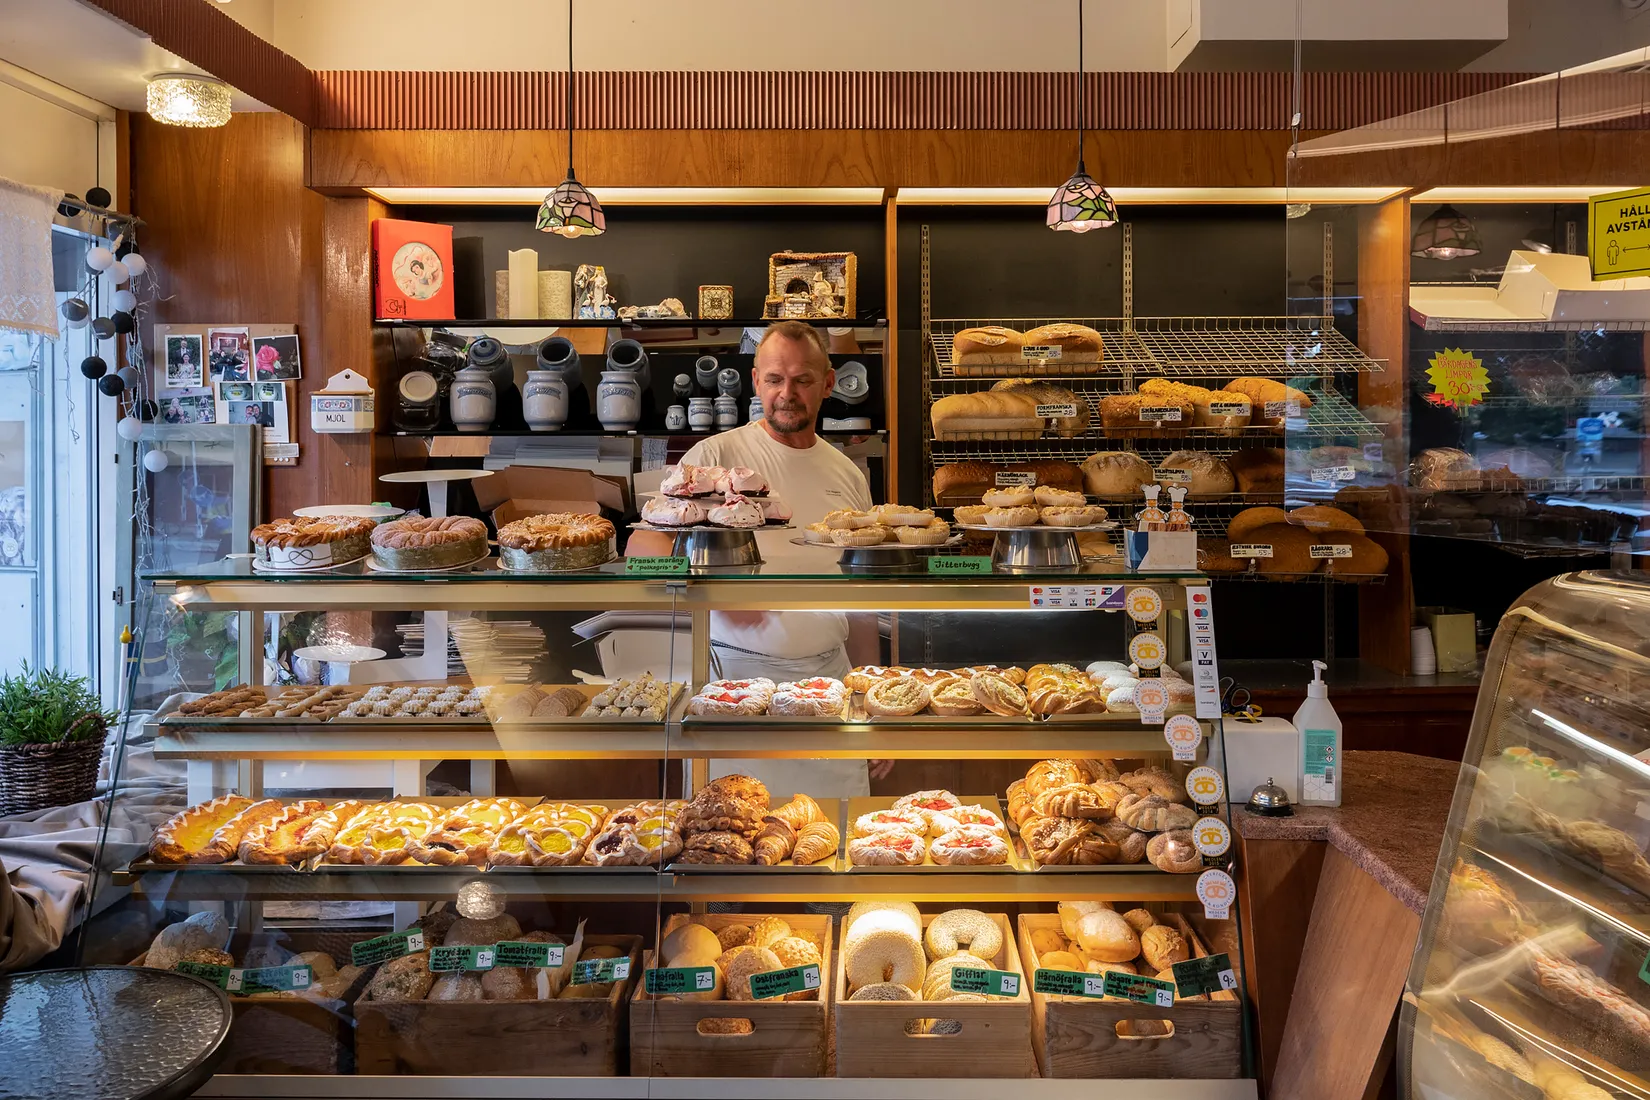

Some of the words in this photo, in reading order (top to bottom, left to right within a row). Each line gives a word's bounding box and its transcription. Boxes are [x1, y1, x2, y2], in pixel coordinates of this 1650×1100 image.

[1620, 204, 1650, 218] HÅLL
[1606, 217, 1650, 234] AVSTÅ
[1445, 370, 1473, 381] LIMPOR
[496, 944, 548, 956] Tomatfralla
[549, 950, 562, 961] 9:-
[480, 953, 492, 964] 9:-
[229, 973, 242, 985] 9:-
[294, 972, 308, 982] 9:-
[755, 969, 799, 984] Ostfranska
[805, 972, 818, 984] 9:-
[954, 968, 987, 979] Gifflar
[697, 974, 712, 986] 7:-
[1003, 978, 1016, 990] 9:-
[1086, 980, 1101, 991] 9:-
[1157, 992, 1171, 1003] 9:-
